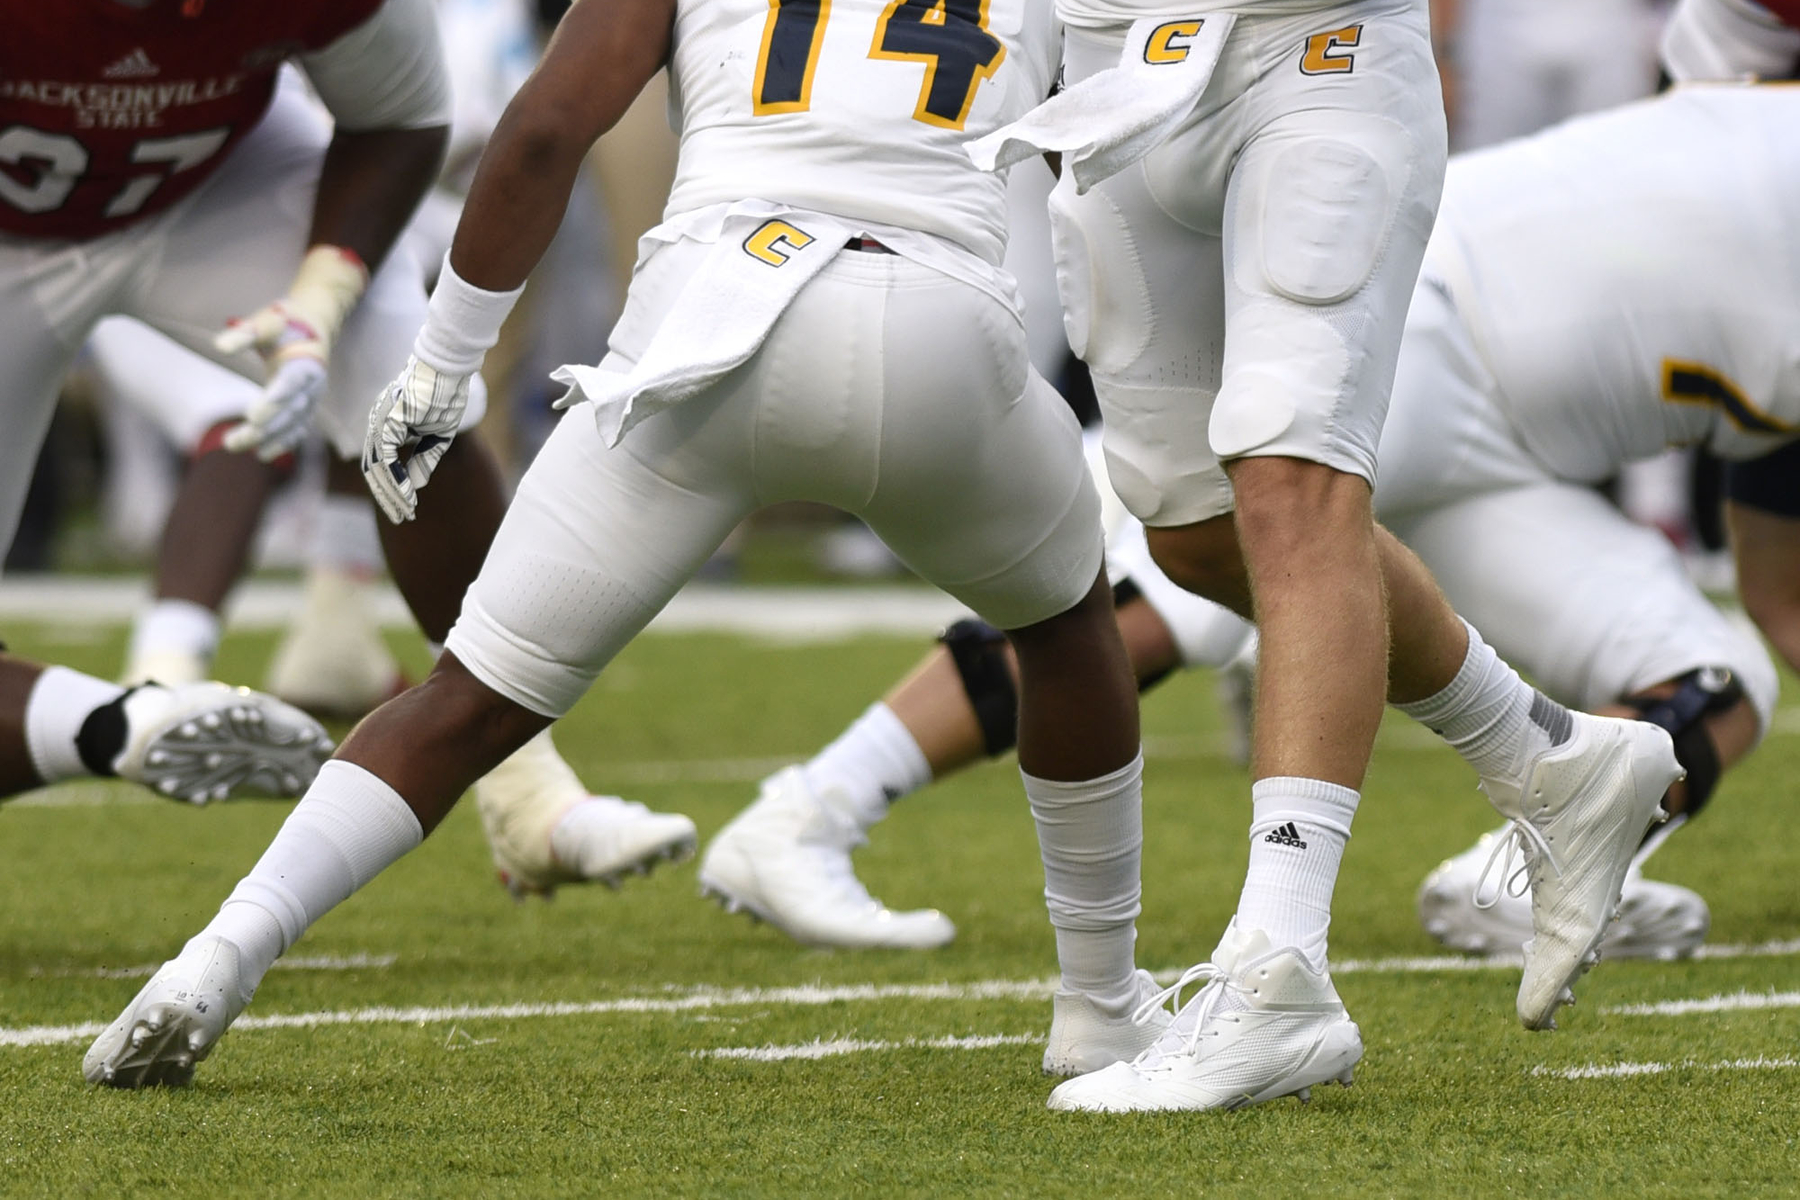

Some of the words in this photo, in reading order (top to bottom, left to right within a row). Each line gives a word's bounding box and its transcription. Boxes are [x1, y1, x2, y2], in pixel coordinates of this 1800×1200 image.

[1144, 18, 1204, 65] C
[1299, 24, 1363, 75] C
[77, 109, 163, 129] STATE
[742, 219, 817, 268] C
[1264, 834, 1307, 850] adidas
